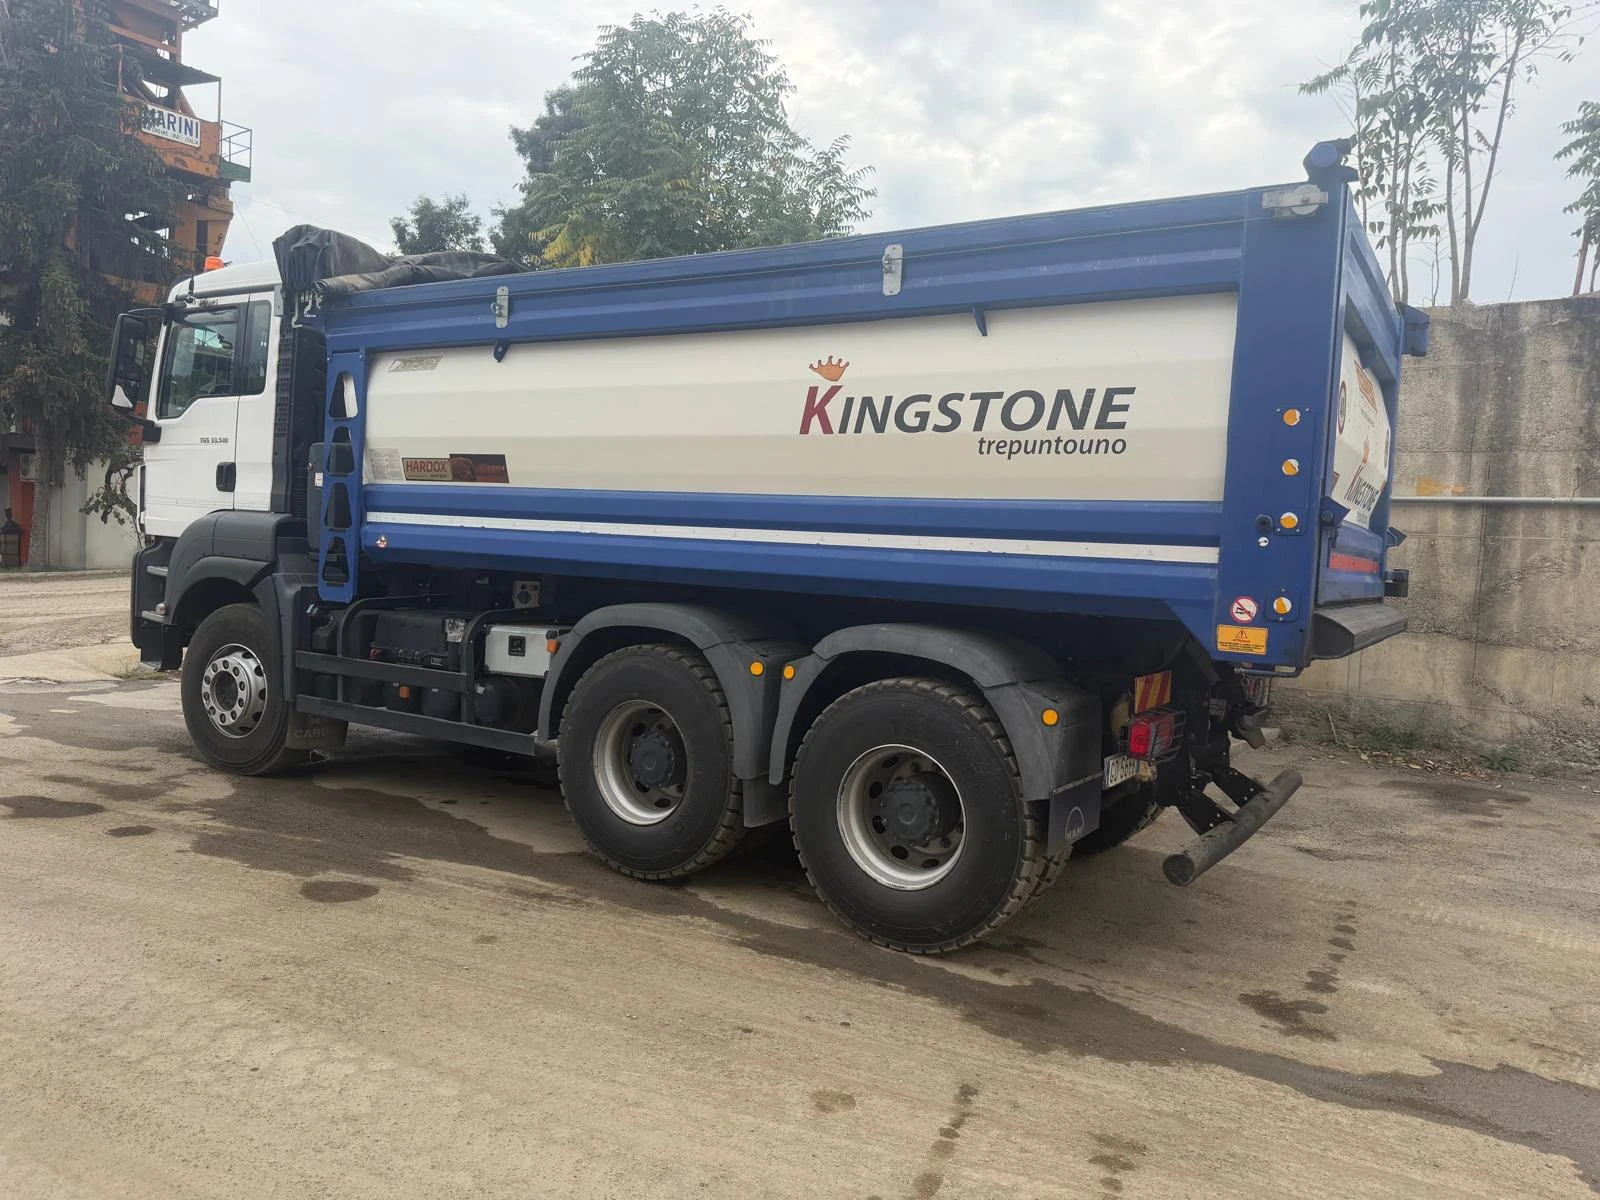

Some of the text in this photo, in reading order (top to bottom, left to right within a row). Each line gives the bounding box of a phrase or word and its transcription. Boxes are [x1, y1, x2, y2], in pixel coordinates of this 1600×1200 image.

[799, 384, 1136, 435] KINGSTONE
[977, 436, 1127, 460] trepuntouno
[405, 460, 447, 473] HARDOX
